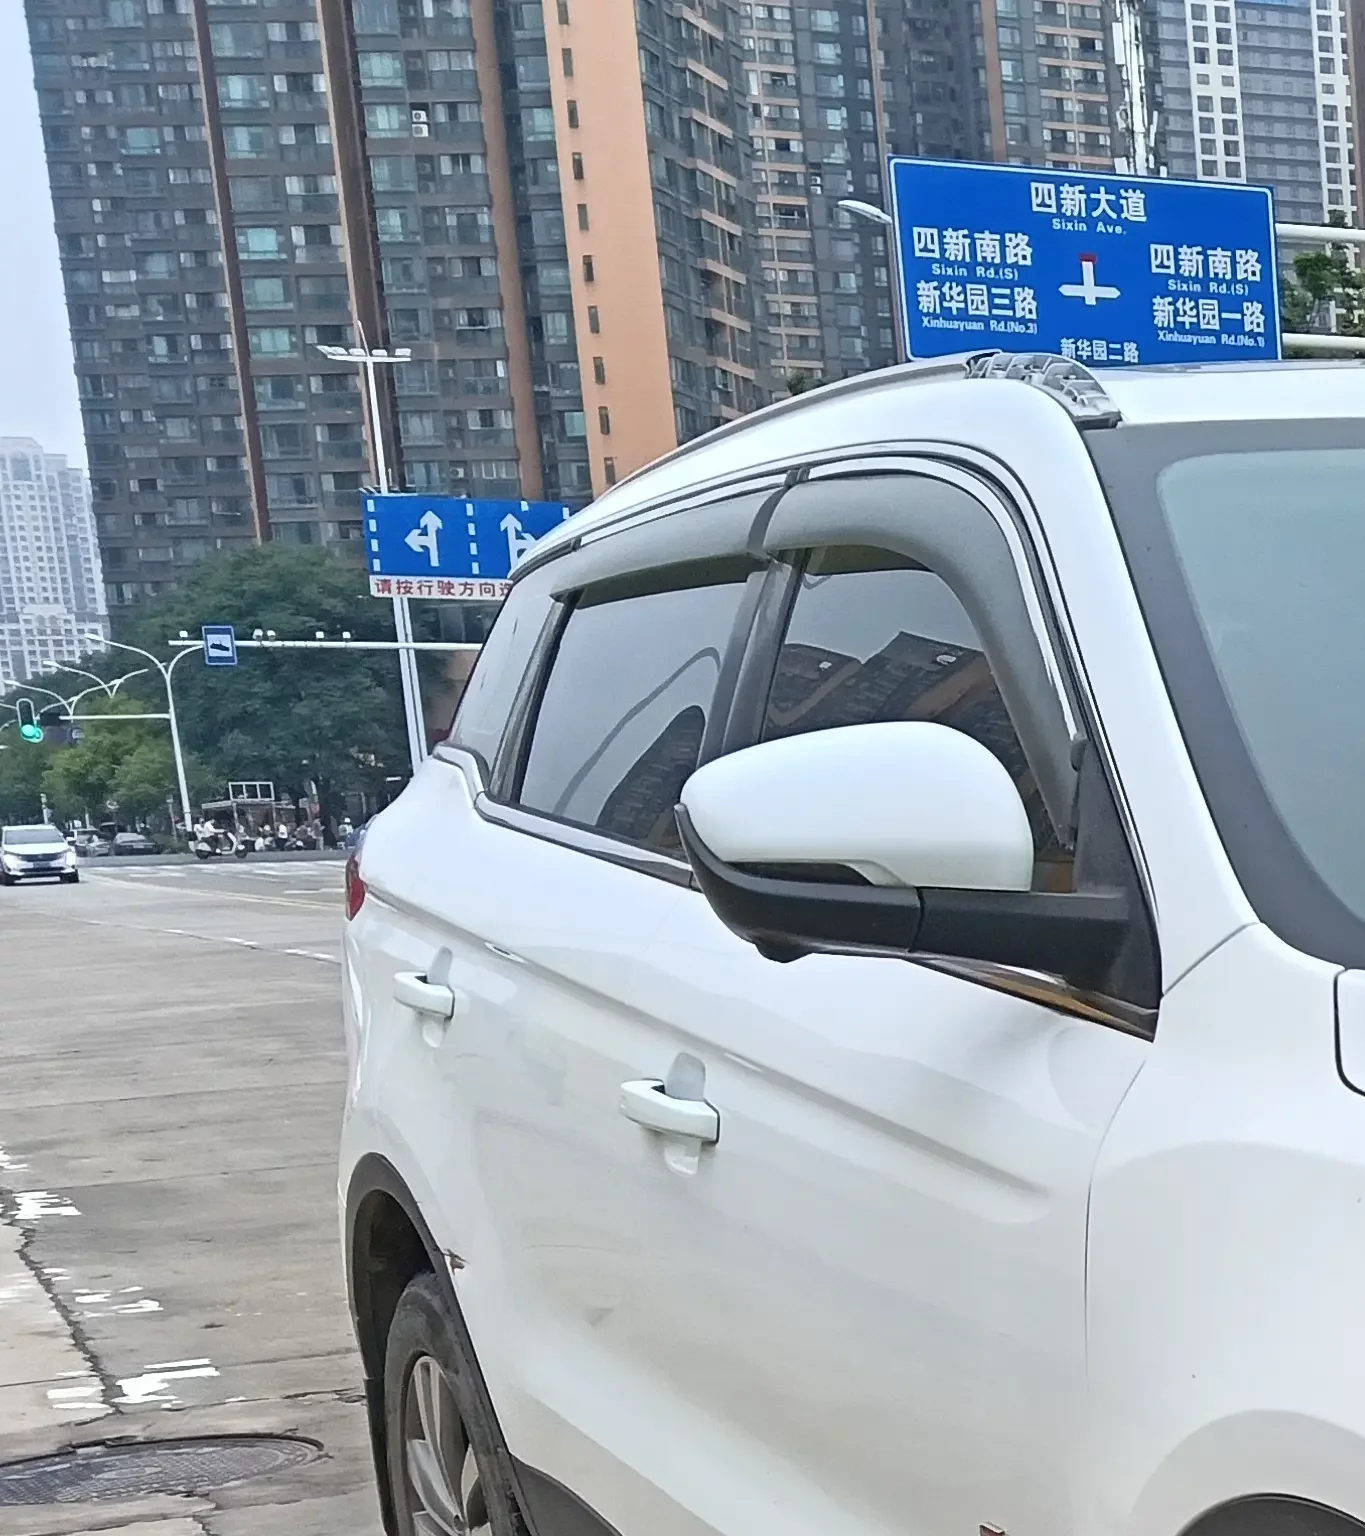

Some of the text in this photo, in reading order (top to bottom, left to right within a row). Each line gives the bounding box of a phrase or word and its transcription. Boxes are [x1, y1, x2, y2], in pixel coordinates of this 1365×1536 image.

[1030, 181, 1147, 222] 四新大道
[1052, 218, 1127, 235] Sixin Ave.
[912, 227, 1033, 266] 四新南路
[931, 264, 1019, 281] Sixin Rd.(S)
[1149, 243, 1262, 282] 四新南路
[917, 280, 1038, 319] 新华园三路
[1167, 279, 1249, 296] Sixin Rd.(S)
[921, 316, 985, 332] Xinhuayuan
[1152, 295, 1265, 333] 新华园一路
[1060, 337, 1139, 363] 新华园二路
[1157, 331, 1215, 346] Xinhuayuan
